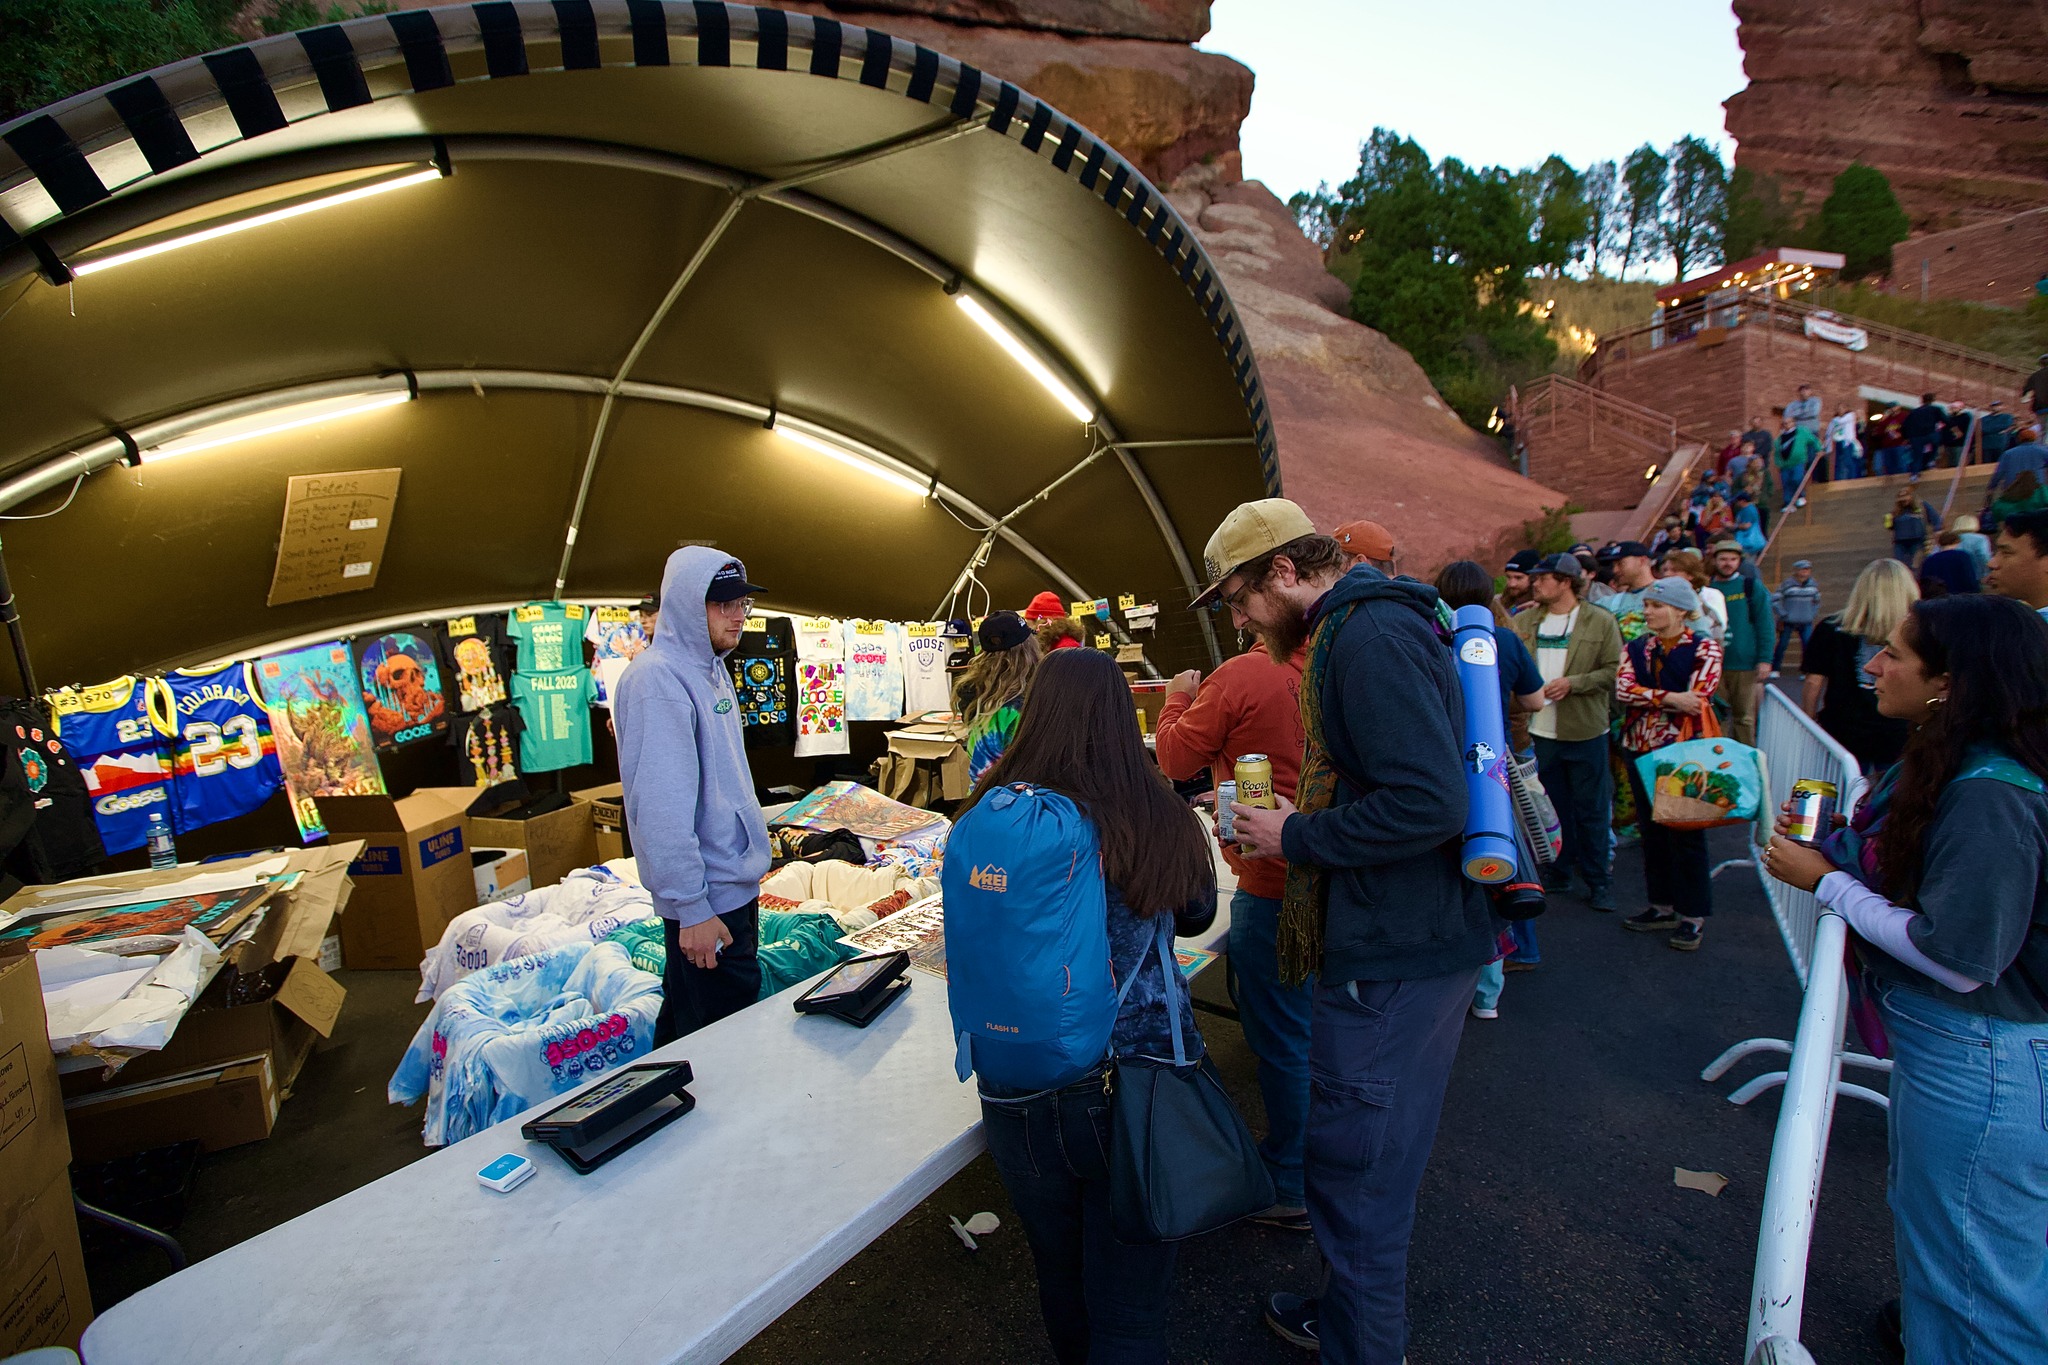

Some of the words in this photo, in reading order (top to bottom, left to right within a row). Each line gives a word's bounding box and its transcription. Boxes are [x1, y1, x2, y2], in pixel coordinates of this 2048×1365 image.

[306, 479, 359, 498] Posters
[749, 620, 764, 629] $80
[815, 620, 830, 629] $50
[909, 638, 945, 652] GOOSE
[531, 677, 554, 691] FALL
[555, 675, 577, 690] 2023
[59, 697, 78, 707] #3
[85, 692, 111, 704] $70
[177, 684, 250, 716] COLORADO
[800, 690, 844, 705] GOOSE
[394, 723, 433, 743] GOOSE
[183, 714, 264, 778] 23
[1242, 779, 1269, 790] Coors
[428, 832, 455, 853] ULINE
[364, 850, 389, 862] LINE
[982, 874, 1007, 887] REI
[986, 1022, 1009, 1033] FLASH
[1010, 1026, 1019, 1034] 18
[546, 1013, 630, 1067] GOOSE
[4, 1303, 25, 1330] WOVEN
[26, 1275, 48, 1303] THROWS
